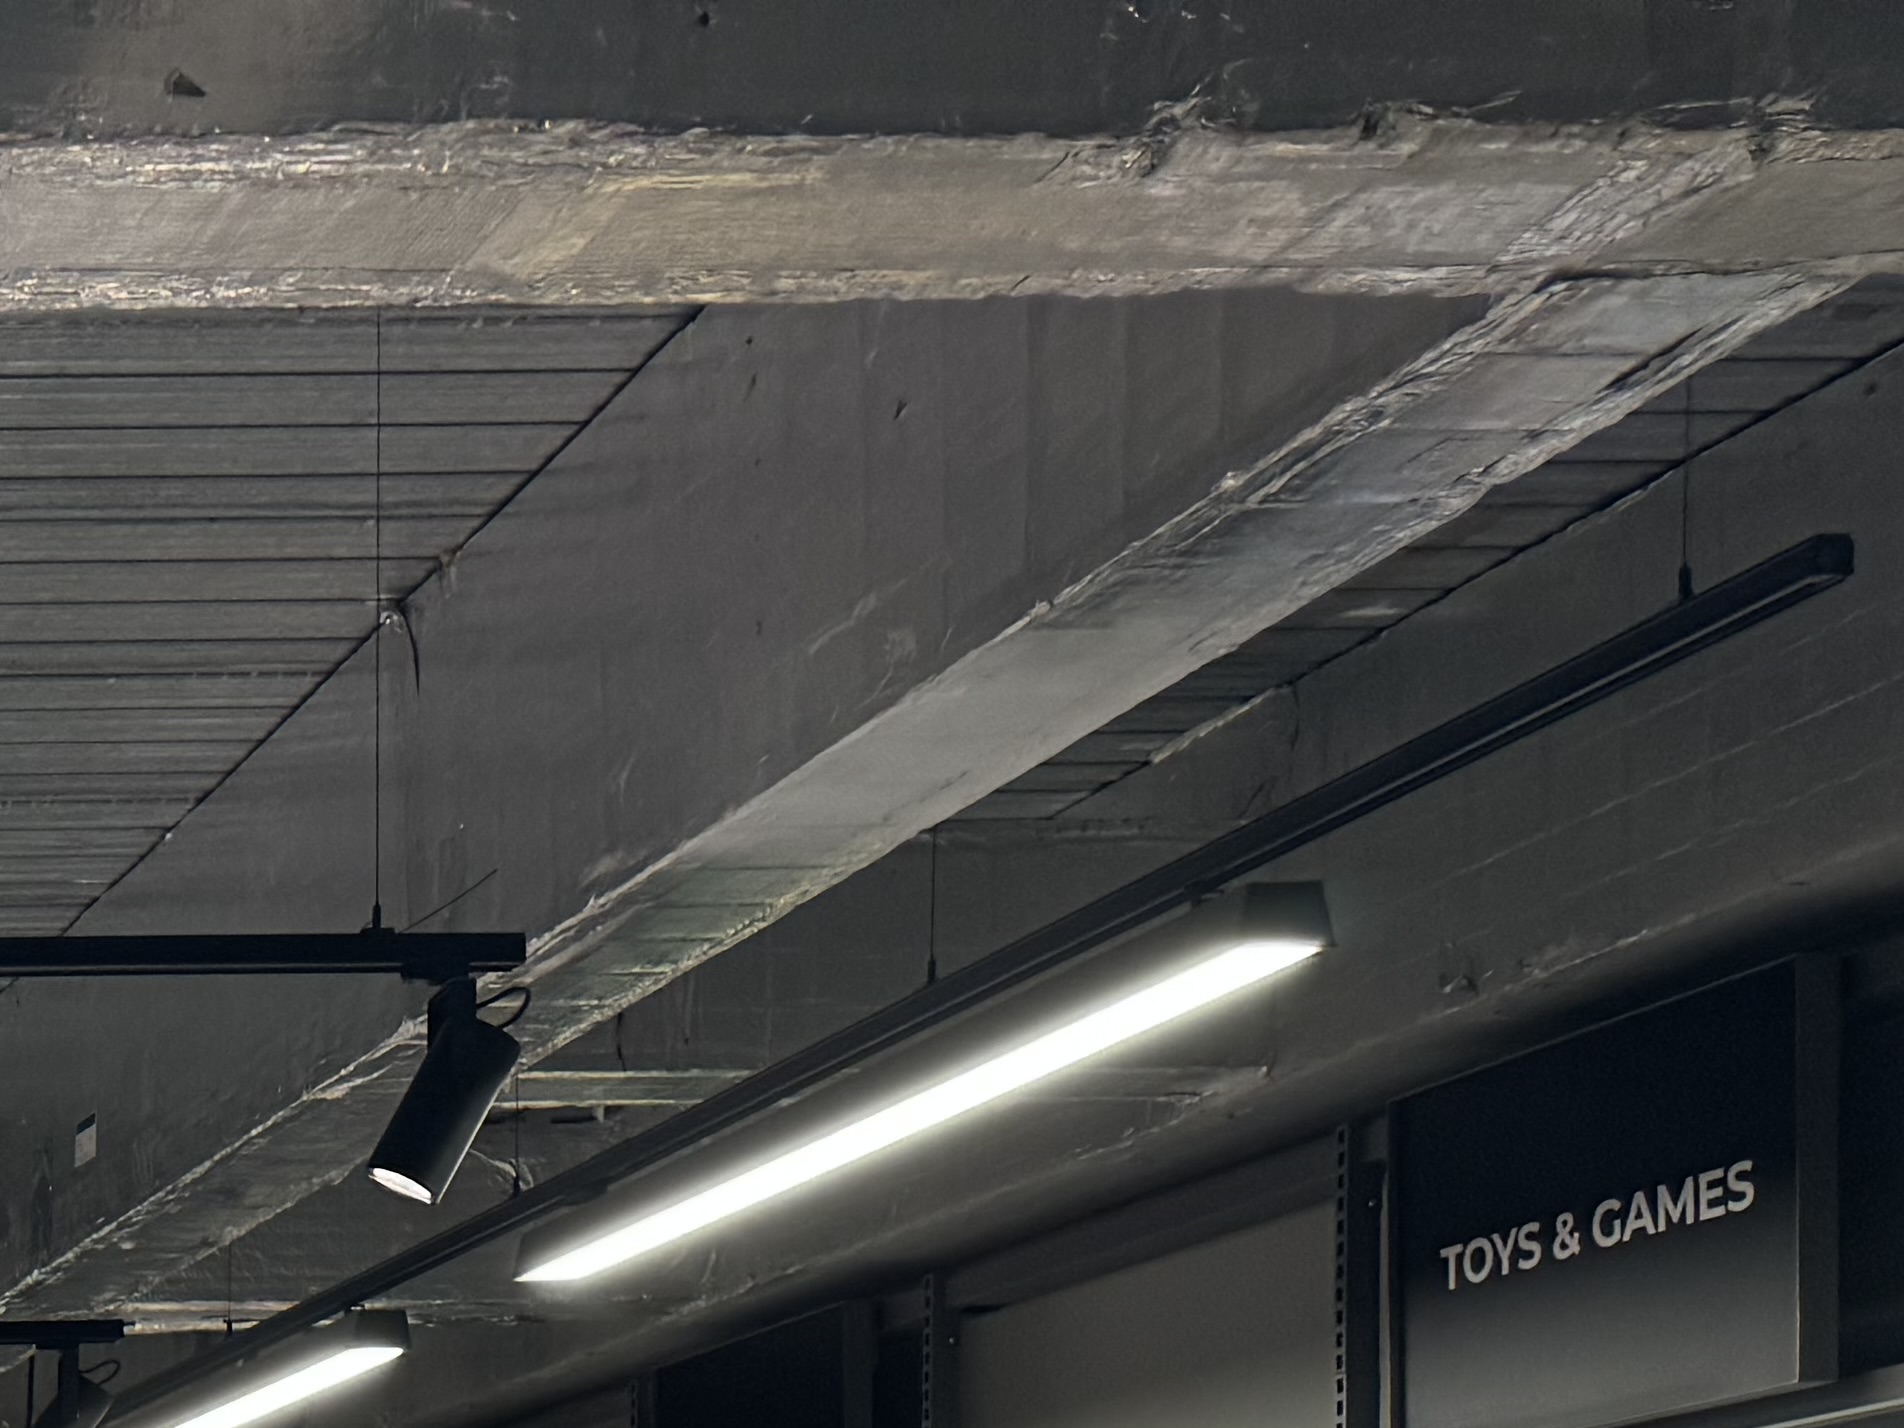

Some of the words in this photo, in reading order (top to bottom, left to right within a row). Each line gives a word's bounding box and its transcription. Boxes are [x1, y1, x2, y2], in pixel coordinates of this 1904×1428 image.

[1441, 1216, 1543, 1292] TOYS
[1553, 1212, 1582, 1258] &
[1591, 1160, 1756, 1250] GAMES
